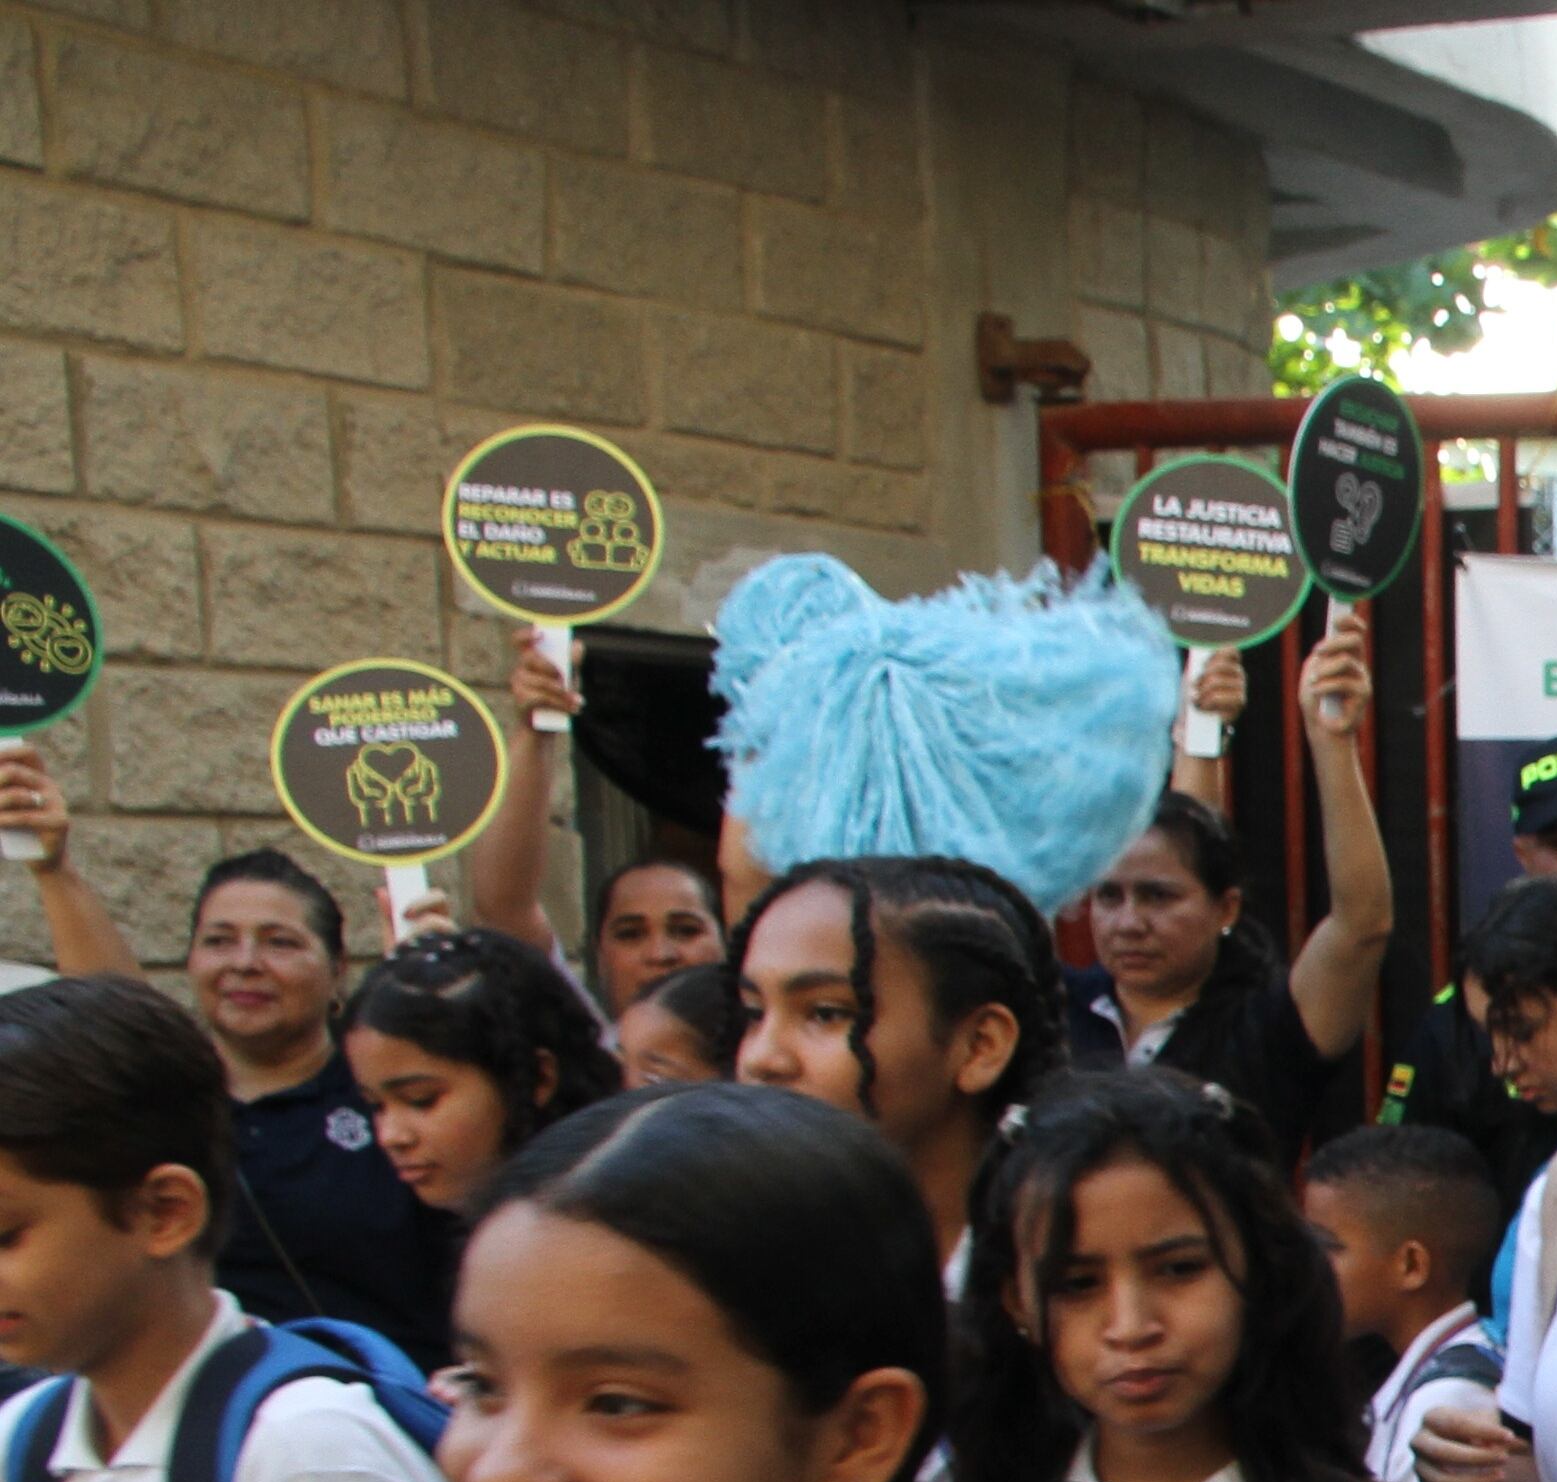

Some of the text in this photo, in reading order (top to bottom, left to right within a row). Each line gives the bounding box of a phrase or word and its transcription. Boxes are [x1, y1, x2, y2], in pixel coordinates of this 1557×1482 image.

[549, 488, 577, 511] ES
[1153, 494, 1283, 530] LA JUSTICIA
[457, 519, 480, 541] EL
[1138, 541, 1289, 579] TRANSFORMA
[1178, 570, 1246, 598] VIDAS
